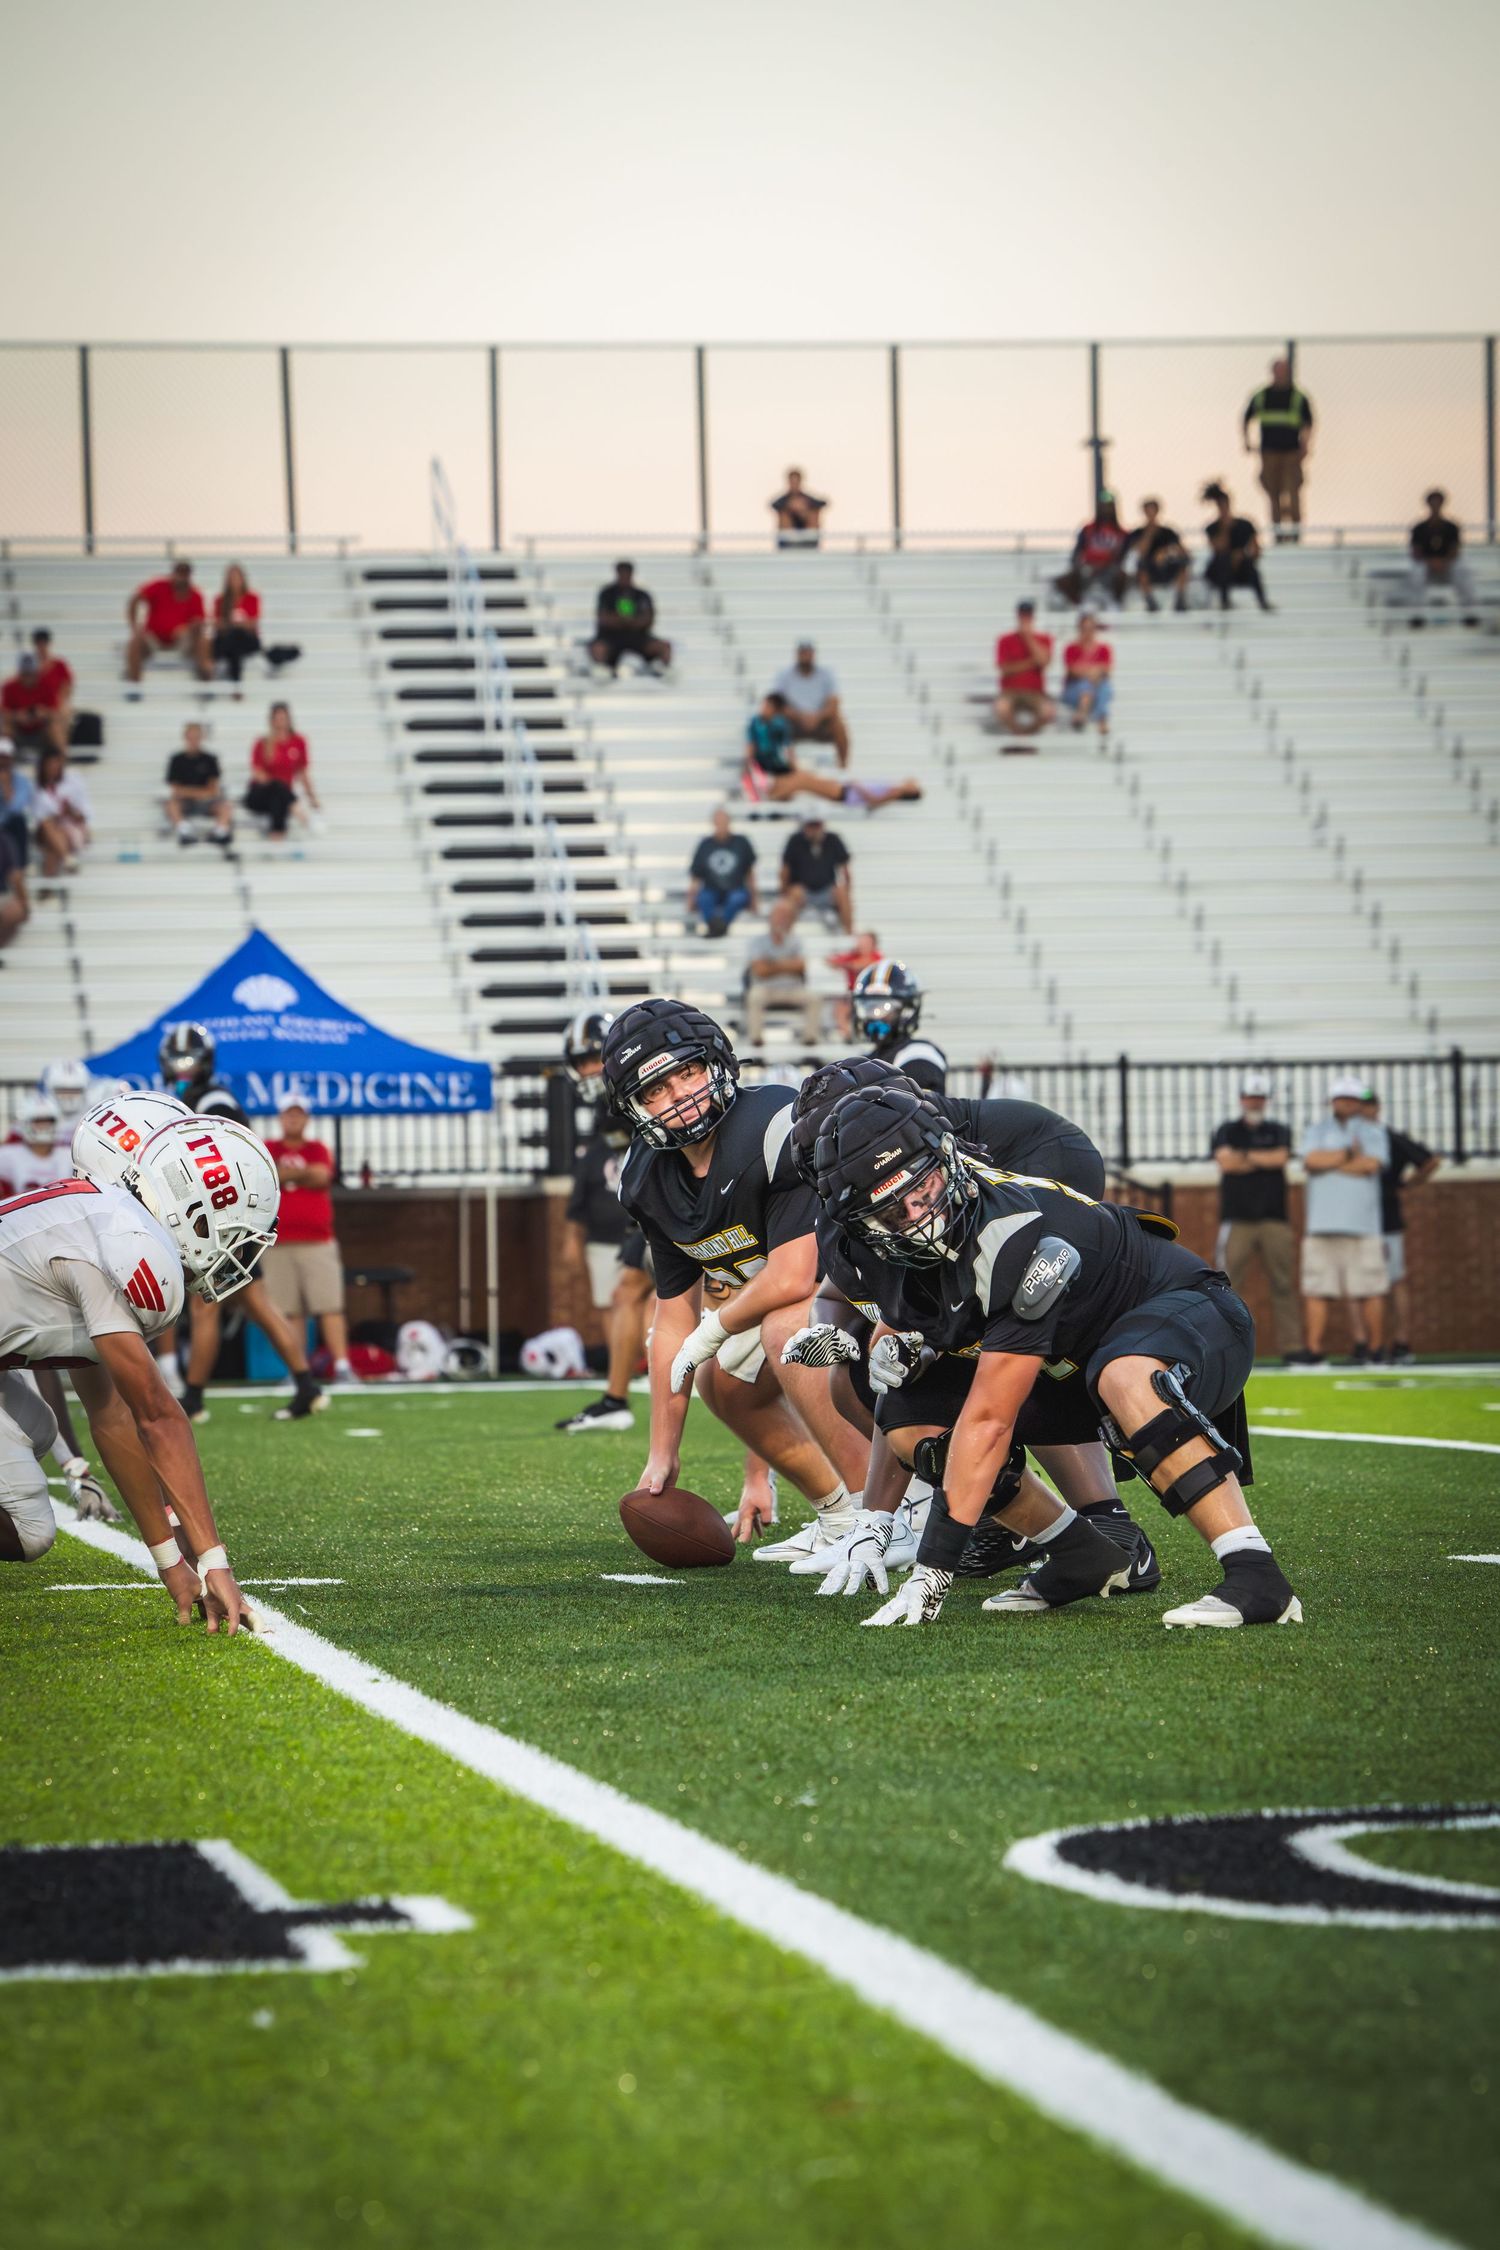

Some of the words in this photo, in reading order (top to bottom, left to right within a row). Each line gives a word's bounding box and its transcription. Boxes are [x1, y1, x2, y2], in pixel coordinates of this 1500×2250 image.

[246, 1070, 477, 1109] MEDICINE
[95, 1110, 141, 1153] 178
[185, 1134, 239, 1210] 1788
[673, 1233, 732, 1260] HMOND
[721, 1224, 759, 1252] HILL
[1022, 1258, 1050, 1295] PRO
